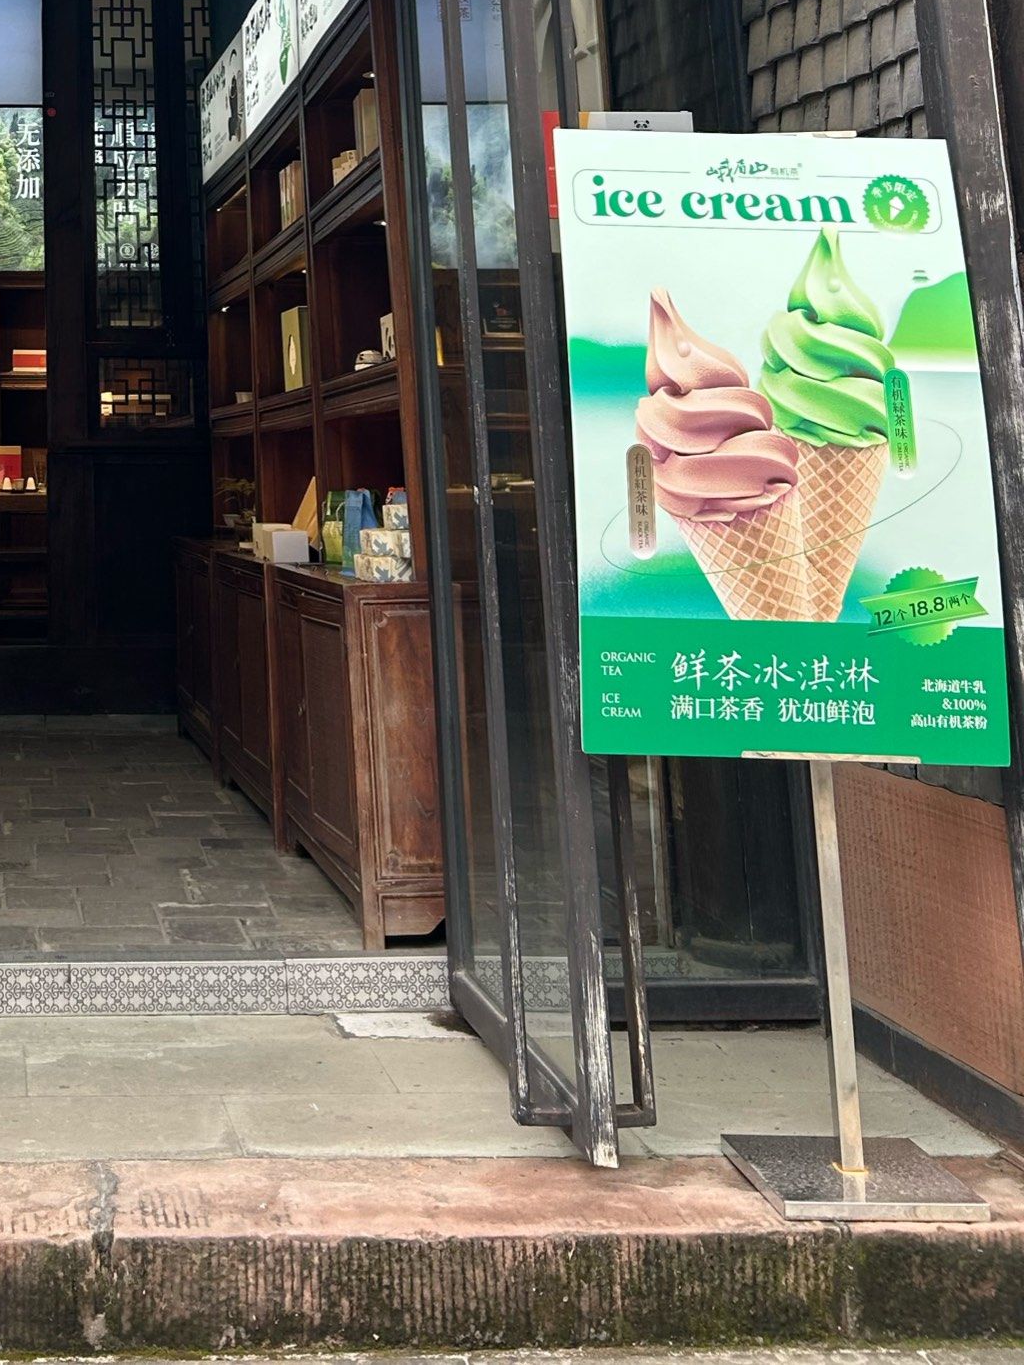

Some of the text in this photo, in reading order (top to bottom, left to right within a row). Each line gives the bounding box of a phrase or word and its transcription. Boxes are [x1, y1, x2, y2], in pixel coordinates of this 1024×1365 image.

[15, 122, 41, 200] 无添加
[592, 175, 665, 218] ice
[681, 192, 857, 223] cream
[601, 651, 656, 663] ORGANIC
[601, 665, 623, 676] TEA
[670, 648, 880, 693] 鲜茶冰淇淋
[921, 678, 987, 694] 北海道牛乳
[602, 693, 621, 704] ICE
[942, 697, 987, 711] &100%
[601, 707, 642, 718] CREAM
[670, 694, 876, 725] 满口茶香 犹如鲜泡
[910, 713, 988, 730] 高山有机茶粉
